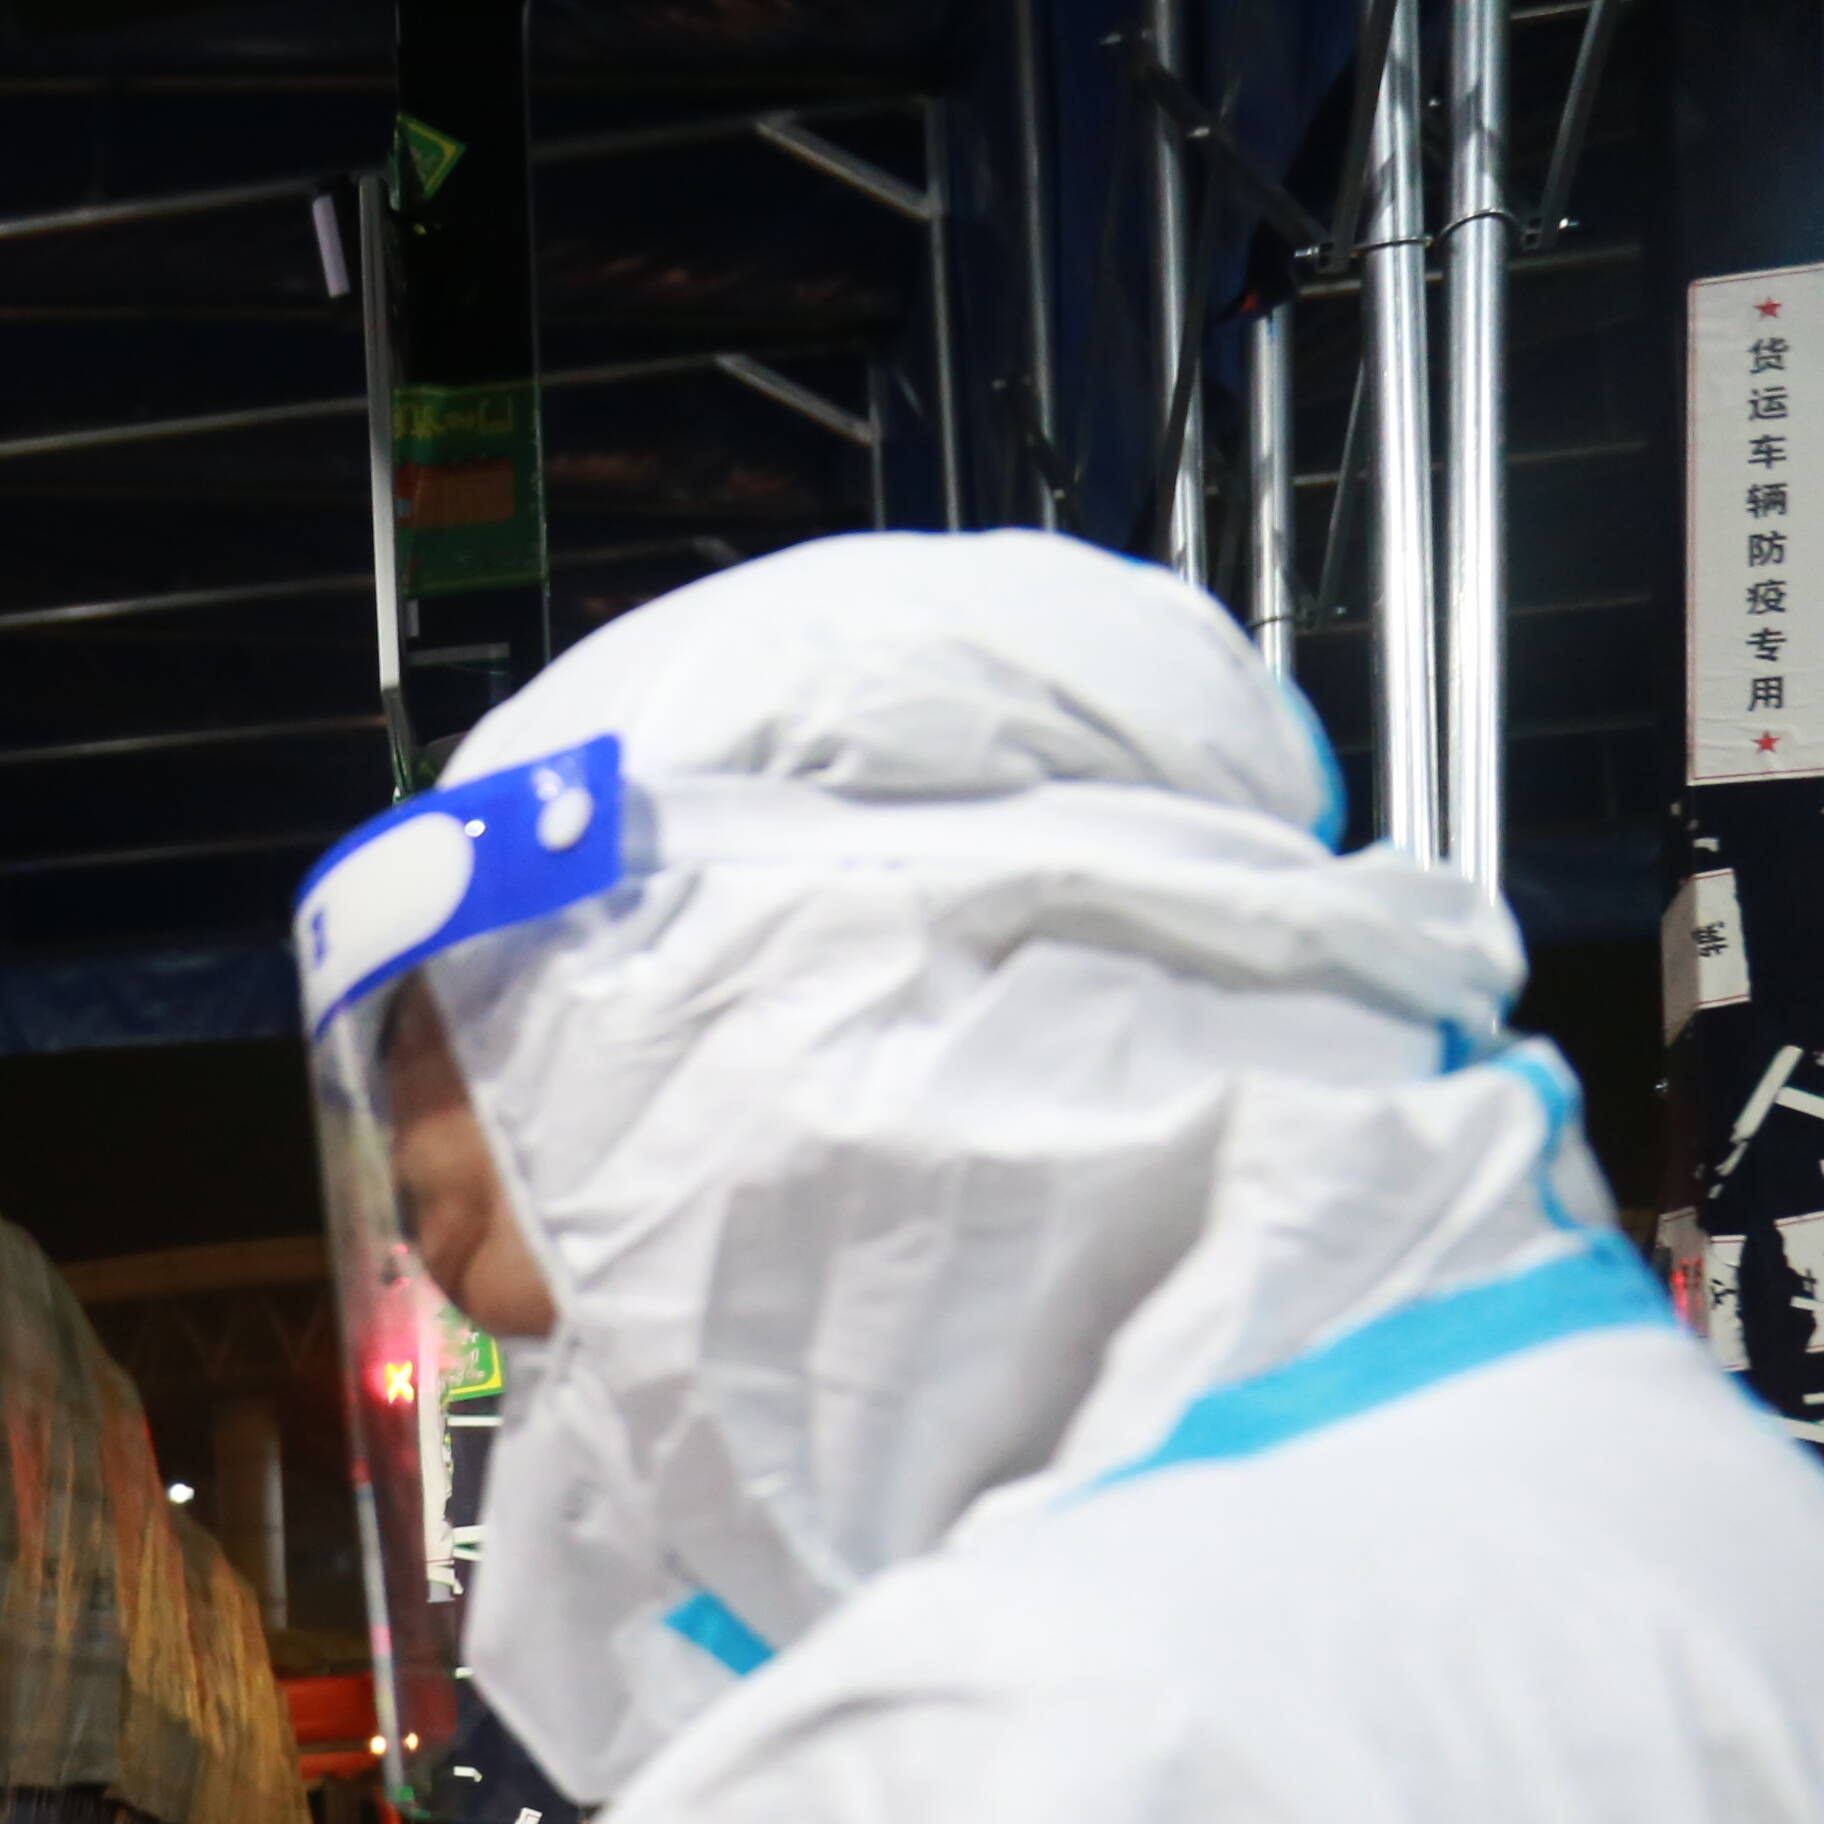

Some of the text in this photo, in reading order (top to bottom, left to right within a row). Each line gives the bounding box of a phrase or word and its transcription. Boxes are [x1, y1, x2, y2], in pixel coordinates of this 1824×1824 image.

[1747, 336, 1790, 713] 货运车辆防疫专用
